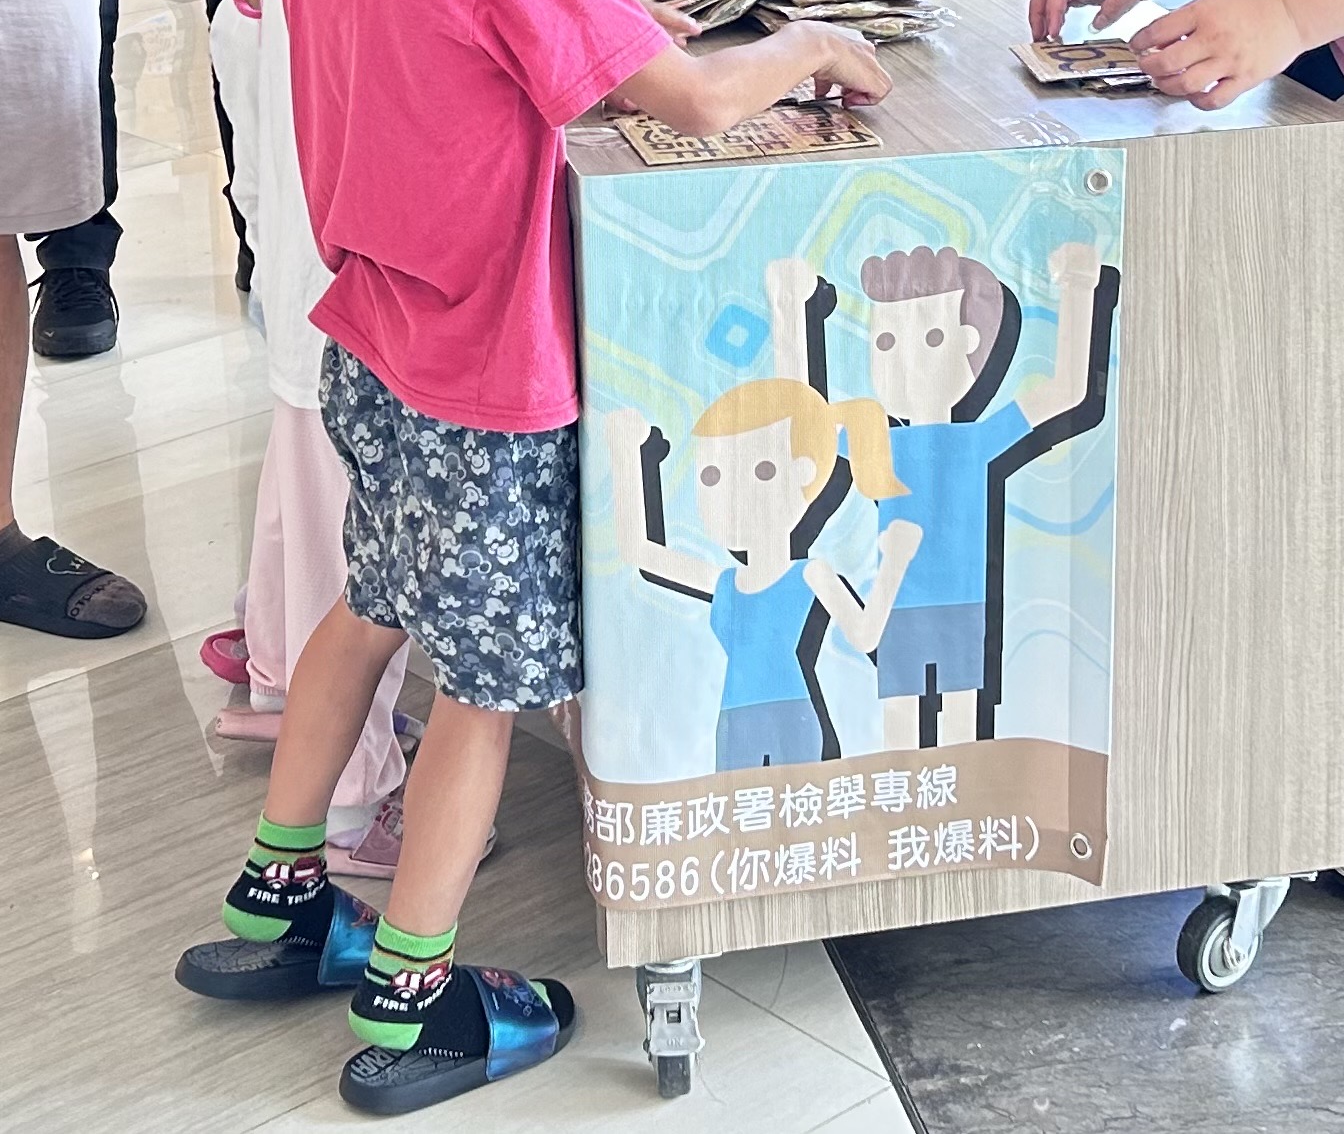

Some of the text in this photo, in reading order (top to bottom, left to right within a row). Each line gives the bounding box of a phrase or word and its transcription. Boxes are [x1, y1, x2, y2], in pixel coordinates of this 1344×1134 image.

[887, 814, 1041, 871] 我爆料)
[247, 887, 281, 904] FIRE
[373, 995, 409, 1012] FIRE
